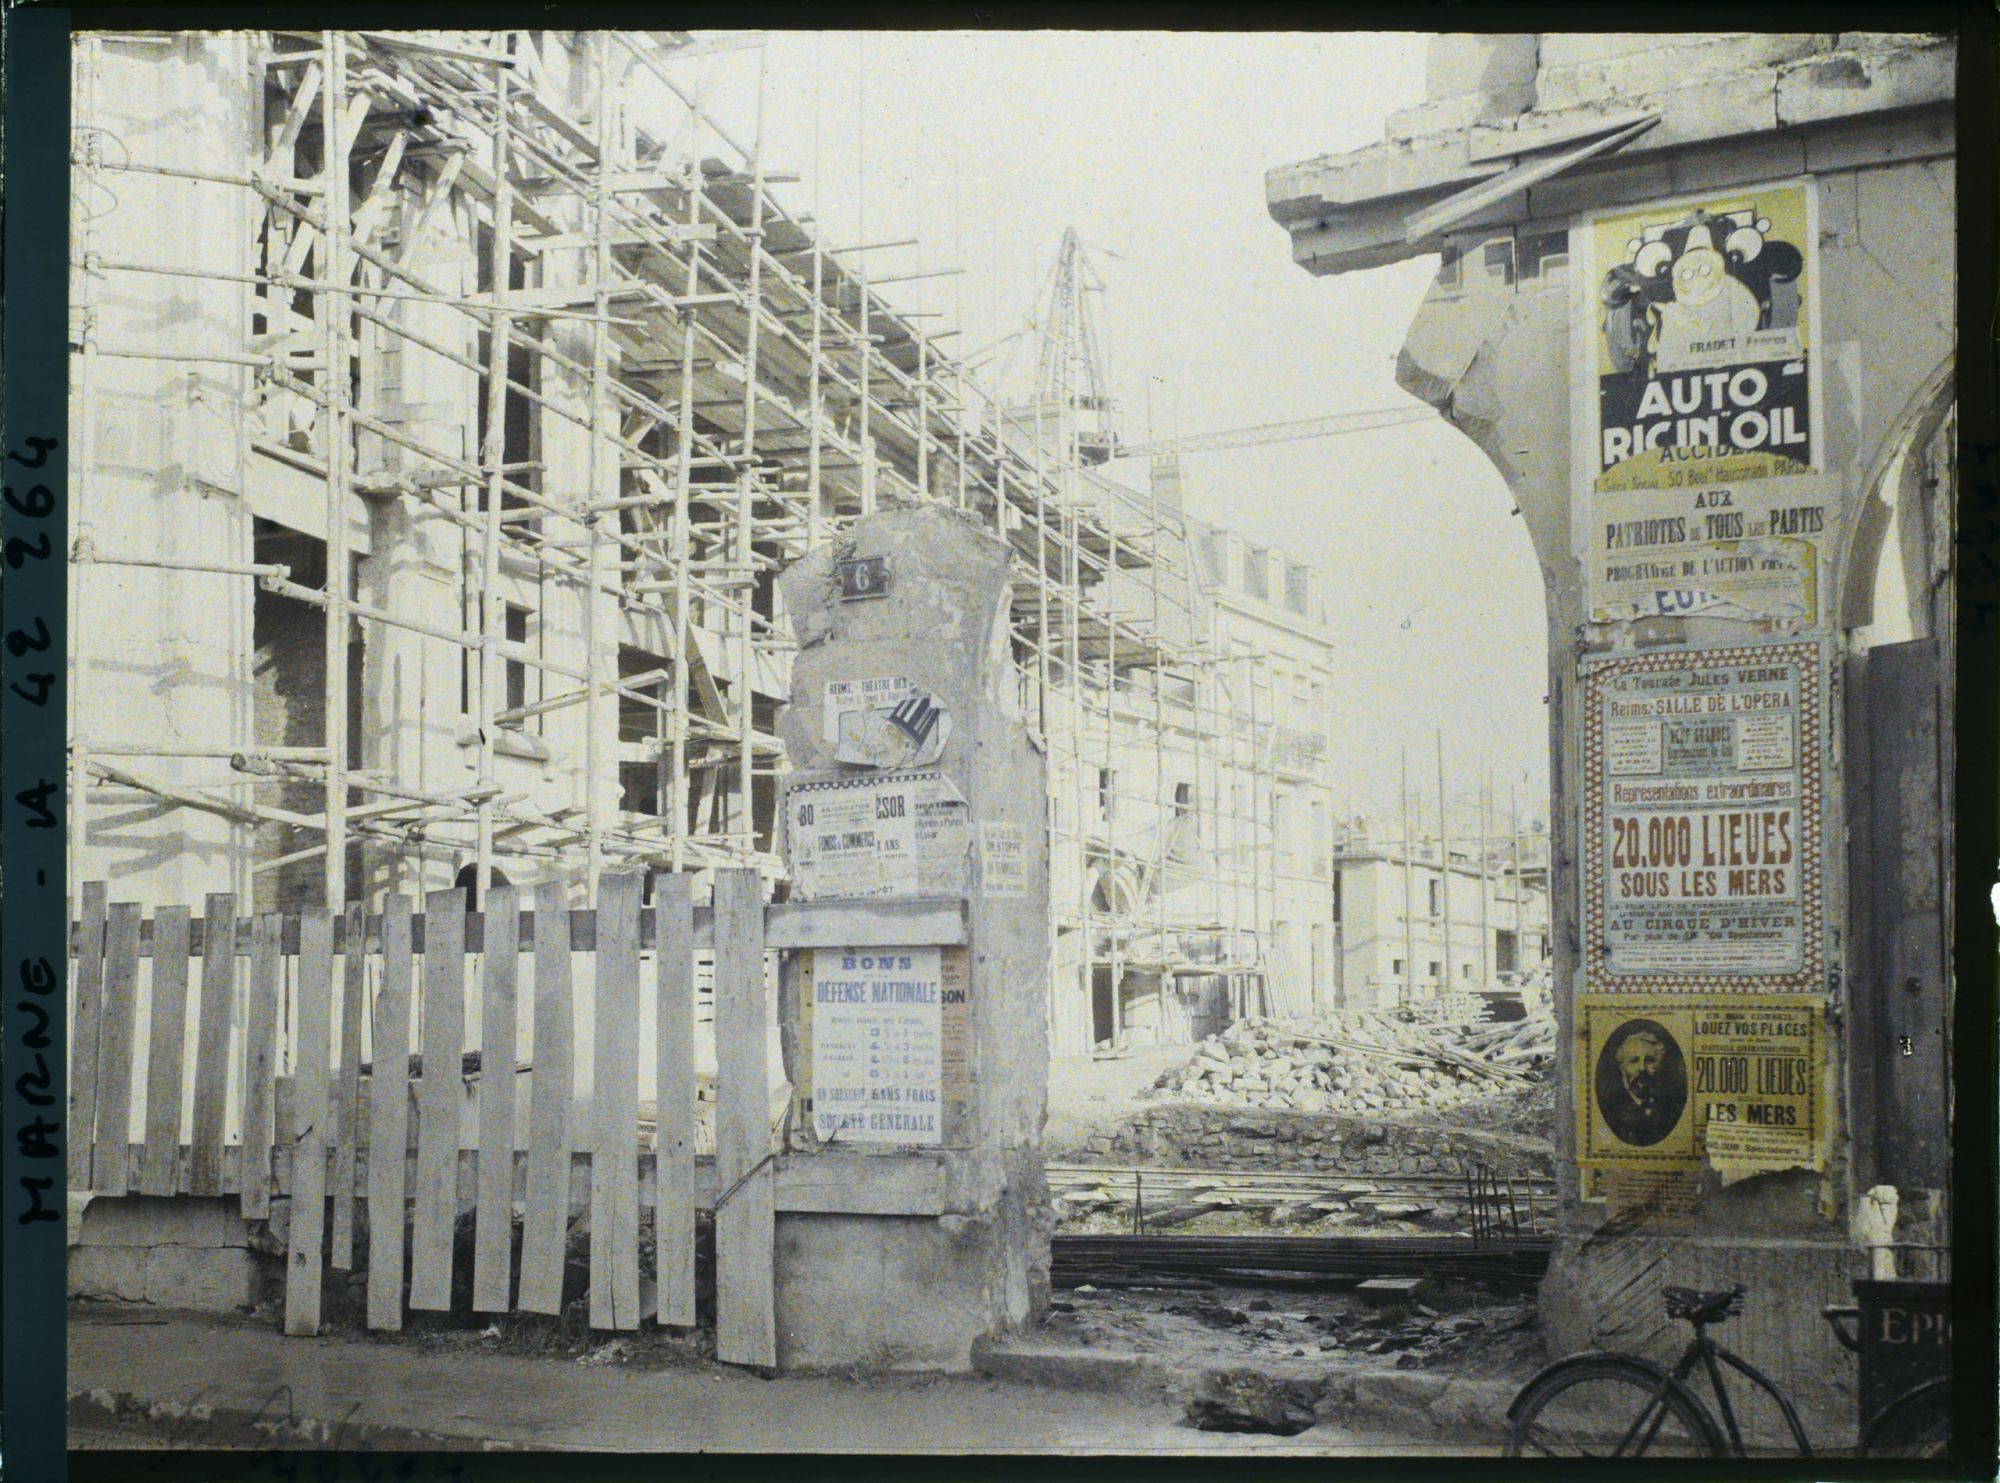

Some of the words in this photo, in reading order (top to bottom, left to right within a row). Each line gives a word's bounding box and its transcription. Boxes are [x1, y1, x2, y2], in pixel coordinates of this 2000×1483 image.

[1690, 337, 1736, 353] FRADET
[1636, 368, 1768, 420] AUTO
[1603, 416, 1720, 466] RICIN
[1729, 407, 1807, 449] OIL
[3, 435, 59, 570] 264
[1694, 490, 1734, 509] AUX
[1606, 516, 1686, 549] PATRIOTES
[1705, 511, 1743, 540] TOUS
[1769, 505, 1825, 535] PARTIS
[854, 563, 871, 591] 6
[6, 616, 56, 707] 42
[1736, 667, 1789, 684] VERNE
[1656, 697, 1702, 715] SALLE
[1707, 696, 1726, 712] DE
[1612, 815, 1691, 868] 20.000
[1701, 811, 1793, 866] LIEUES
[1620, 871, 1670, 898] SOUS
[1681, 870, 1717, 897] LES
[1728, 868, 1786, 896] MERS
[1610, 919, 1634, 931] AU
[1645, 918, 1710, 930] CIRQUE
[1720, 916, 1796, 929] D'HIVER
[841, 956, 912, 970] BONS
[871, 981, 937, 1004] NATIONALE
[1695, 1021, 1731, 1035] LOUEZ
[1734, 1022, 1758, 1035] VOS
[1761, 1023, 1807, 1037] PLACES
[1695, 1056, 1748, 1094] 20.000
[1757, 1057, 1807, 1095] LIEUES
[15, 956, 61, 1225] MARNE
[872, 1087, 901, 1101] SANS
[906, 1088, 936, 1103] FRAIS
[1706, 1103, 1737, 1122] LES
[1747, 1103, 1796, 1125] MERS
[1880, 1307, 1952, 1345] EPI
